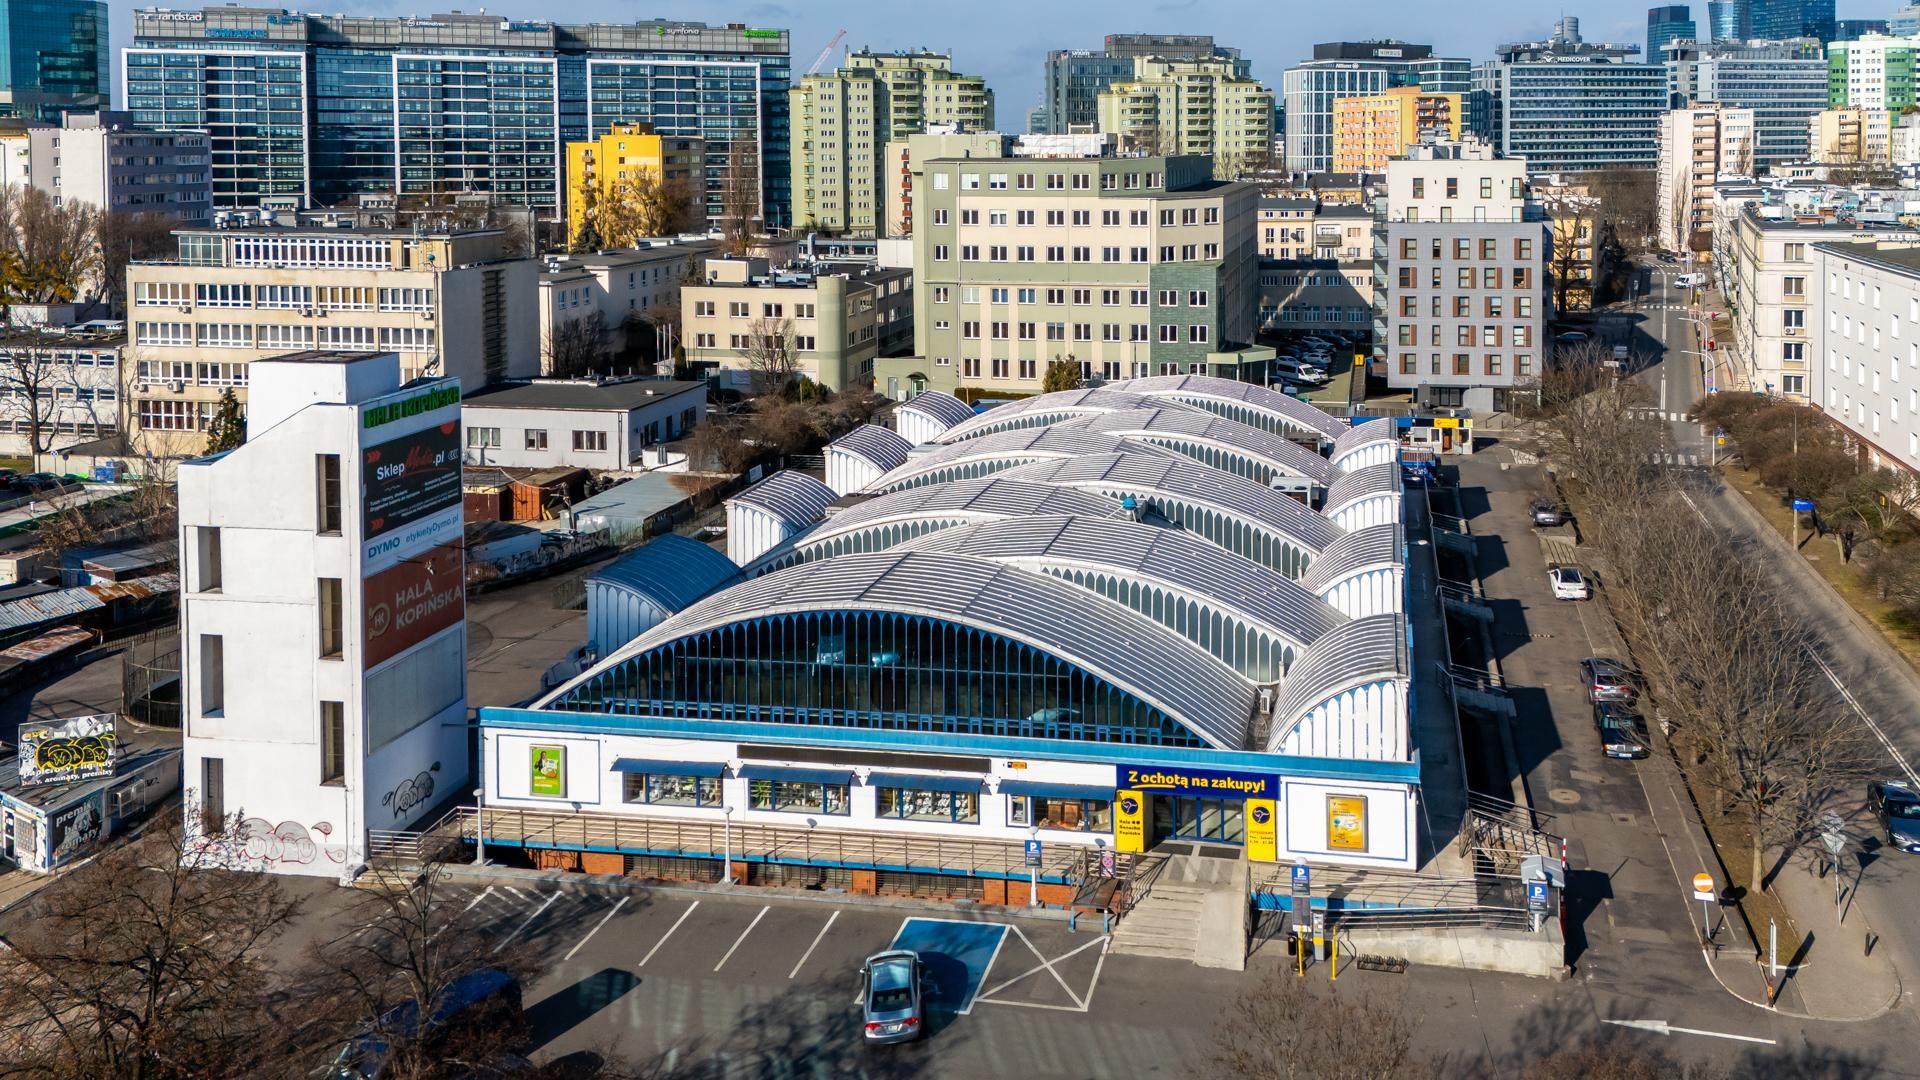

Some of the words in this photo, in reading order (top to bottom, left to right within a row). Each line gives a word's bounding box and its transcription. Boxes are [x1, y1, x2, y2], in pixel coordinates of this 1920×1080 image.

[158, 12, 202, 20] randstad
[363, 402, 401, 429] HALA
[368, 536, 401, 559] DYMO
[395, 578, 433, 609] HALA
[395, 585, 463, 630] KOPIŃSKA
[1129, 771, 1138, 782] Z
[1140, 772, 1189, 788] ochotą
[1191, 776, 1209, 787] na
[1211, 777, 1265, 793] zakupy!
[1029, 842, 1037, 851] P
[1297, 867, 1305, 878] P
[1534, 886, 1543, 897] P
